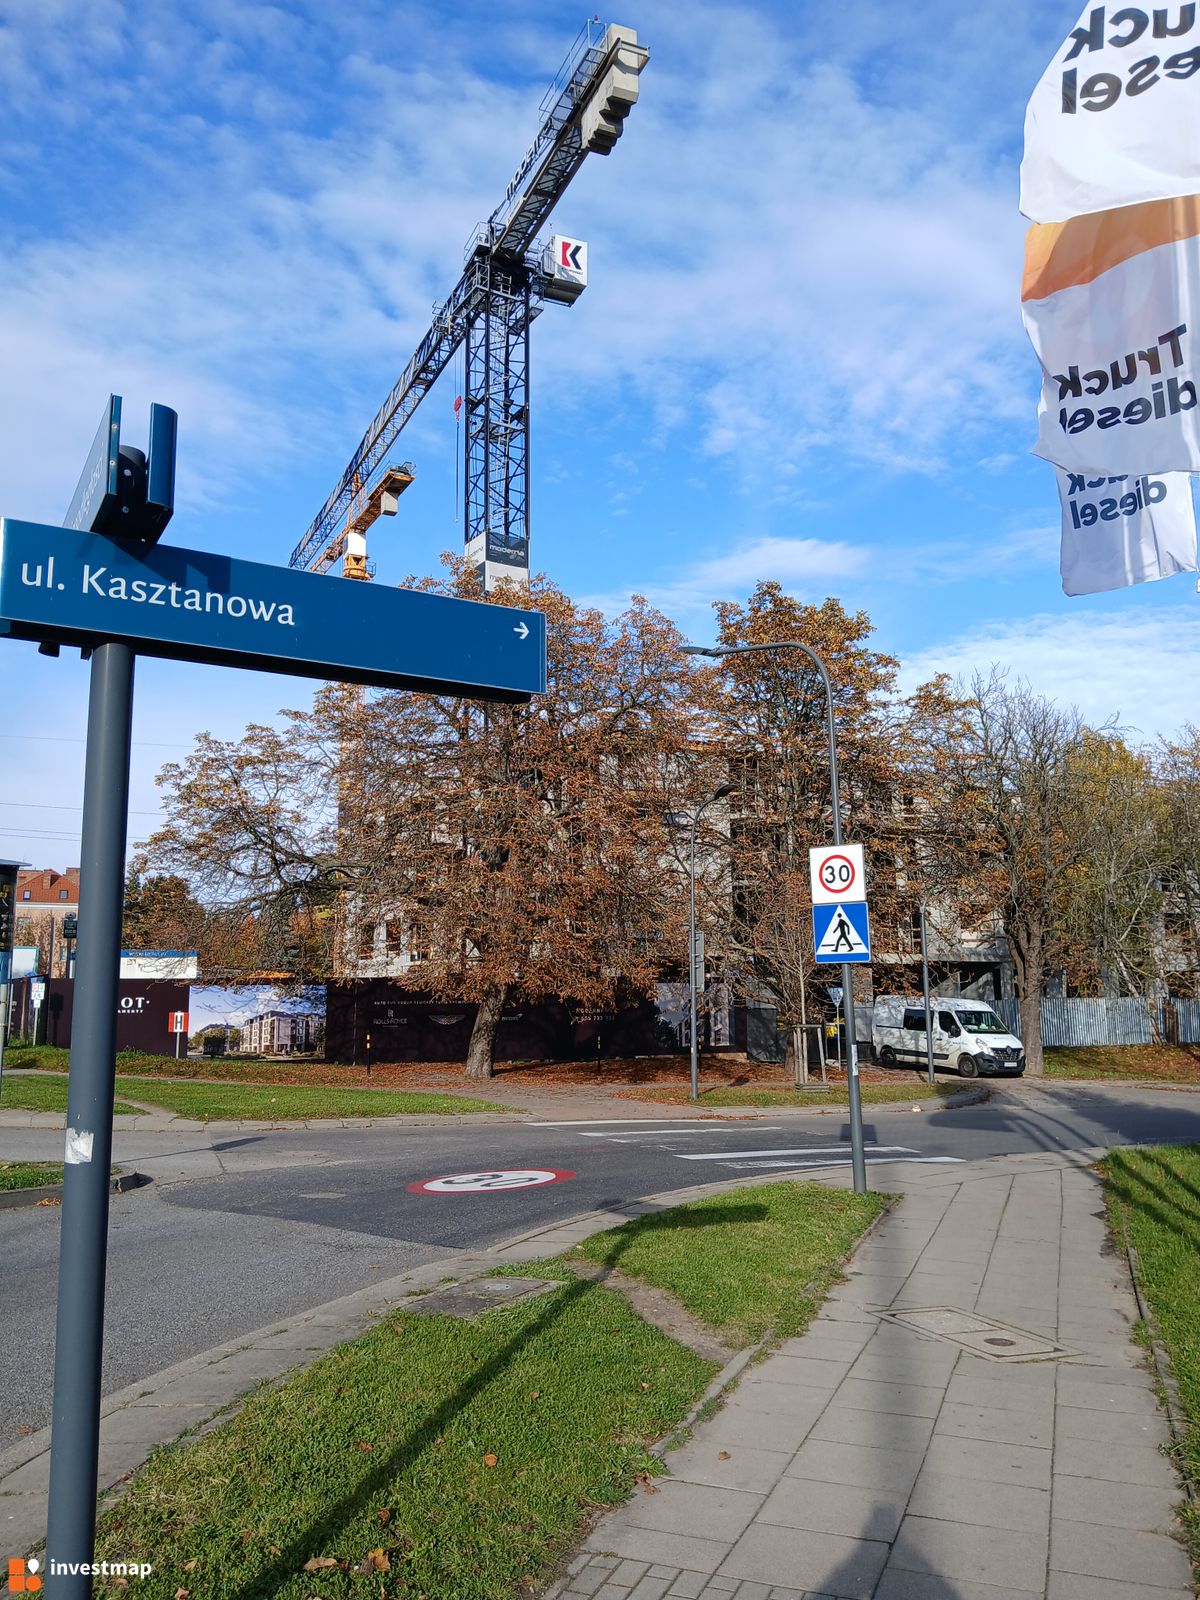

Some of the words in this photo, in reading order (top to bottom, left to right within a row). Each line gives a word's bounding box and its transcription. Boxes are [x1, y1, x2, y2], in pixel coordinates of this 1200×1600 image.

[489, 544, 525, 555] moderna
[22, 557, 64, 590] ul.
[82, 564, 295, 625] Kasztanowa
[825, 865, 849, 883] 30
